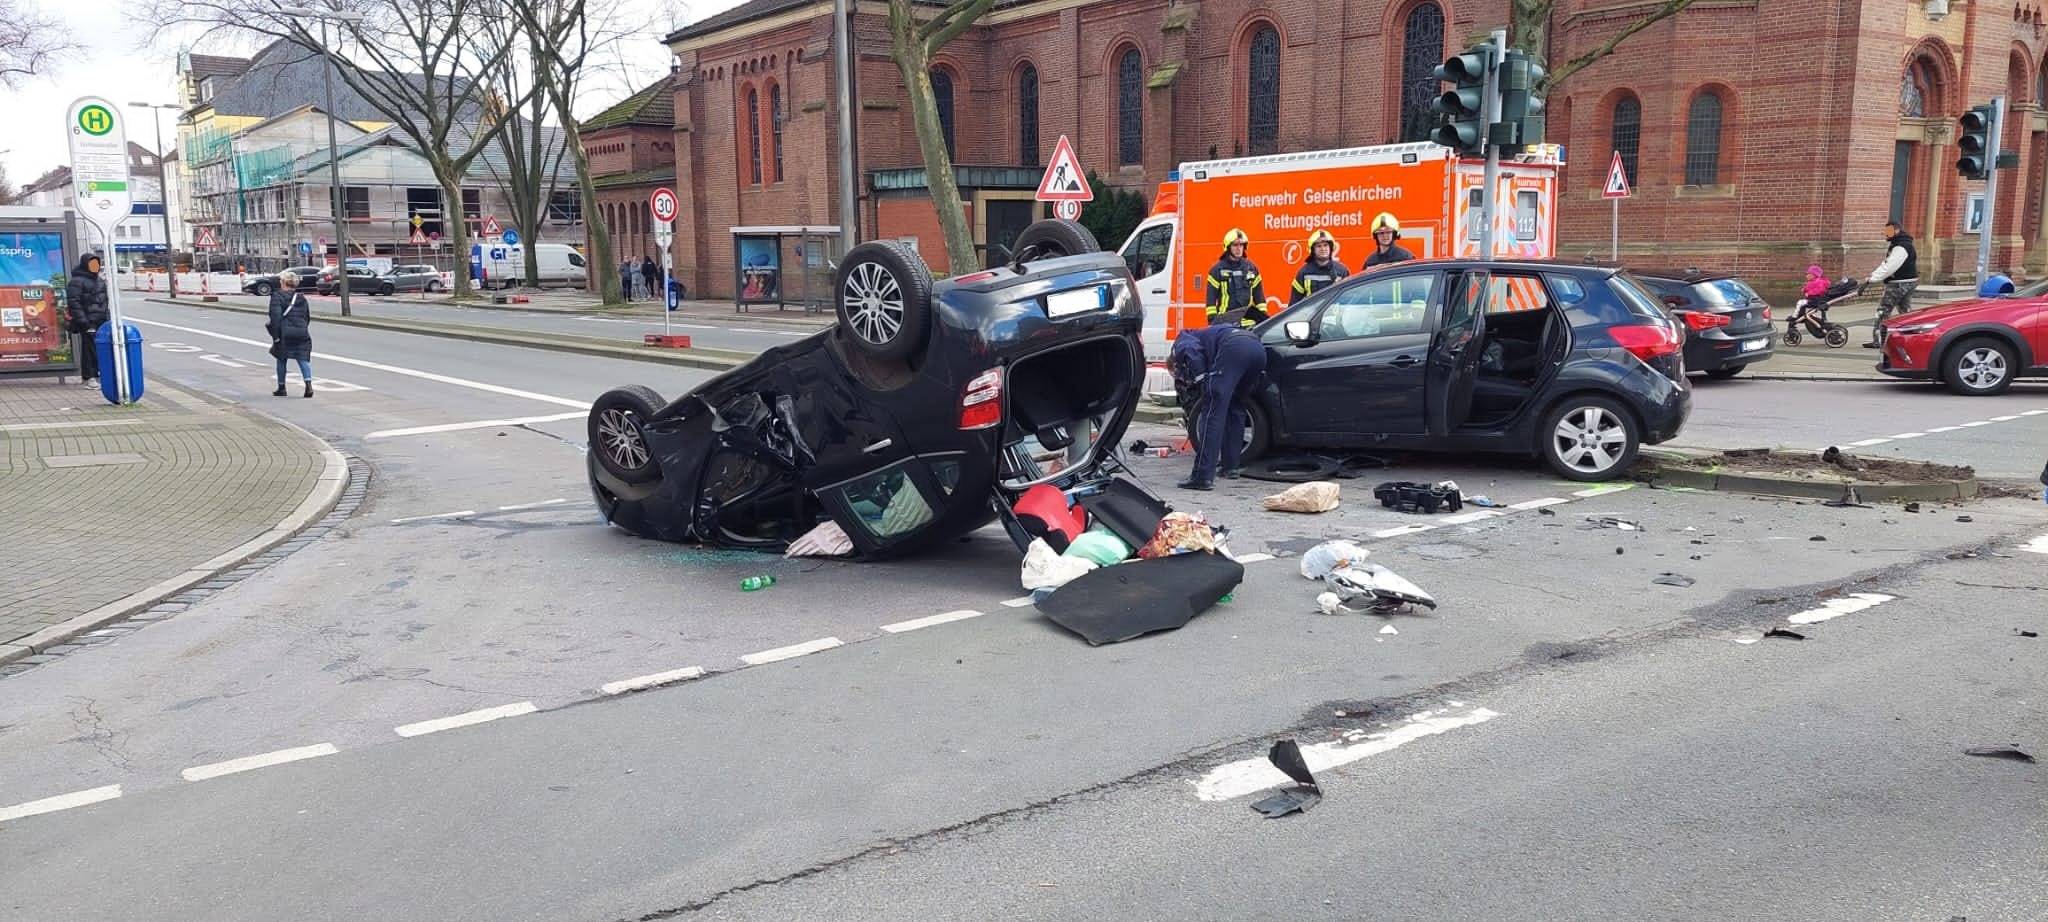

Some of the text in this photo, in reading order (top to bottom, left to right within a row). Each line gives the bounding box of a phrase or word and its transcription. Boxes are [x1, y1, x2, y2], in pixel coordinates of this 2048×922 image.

[88, 111, 104, 128] H
[73, 126, 81, 135] 6
[1232, 184, 1402, 209] Feuerwehr Gelsenkirchen
[657, 198, 673, 214] 30
[1264, 209, 1362, 232] Rettungsdienst
[1518, 216, 1535, 233] 112
[22, 289, 42, 298] NEU
